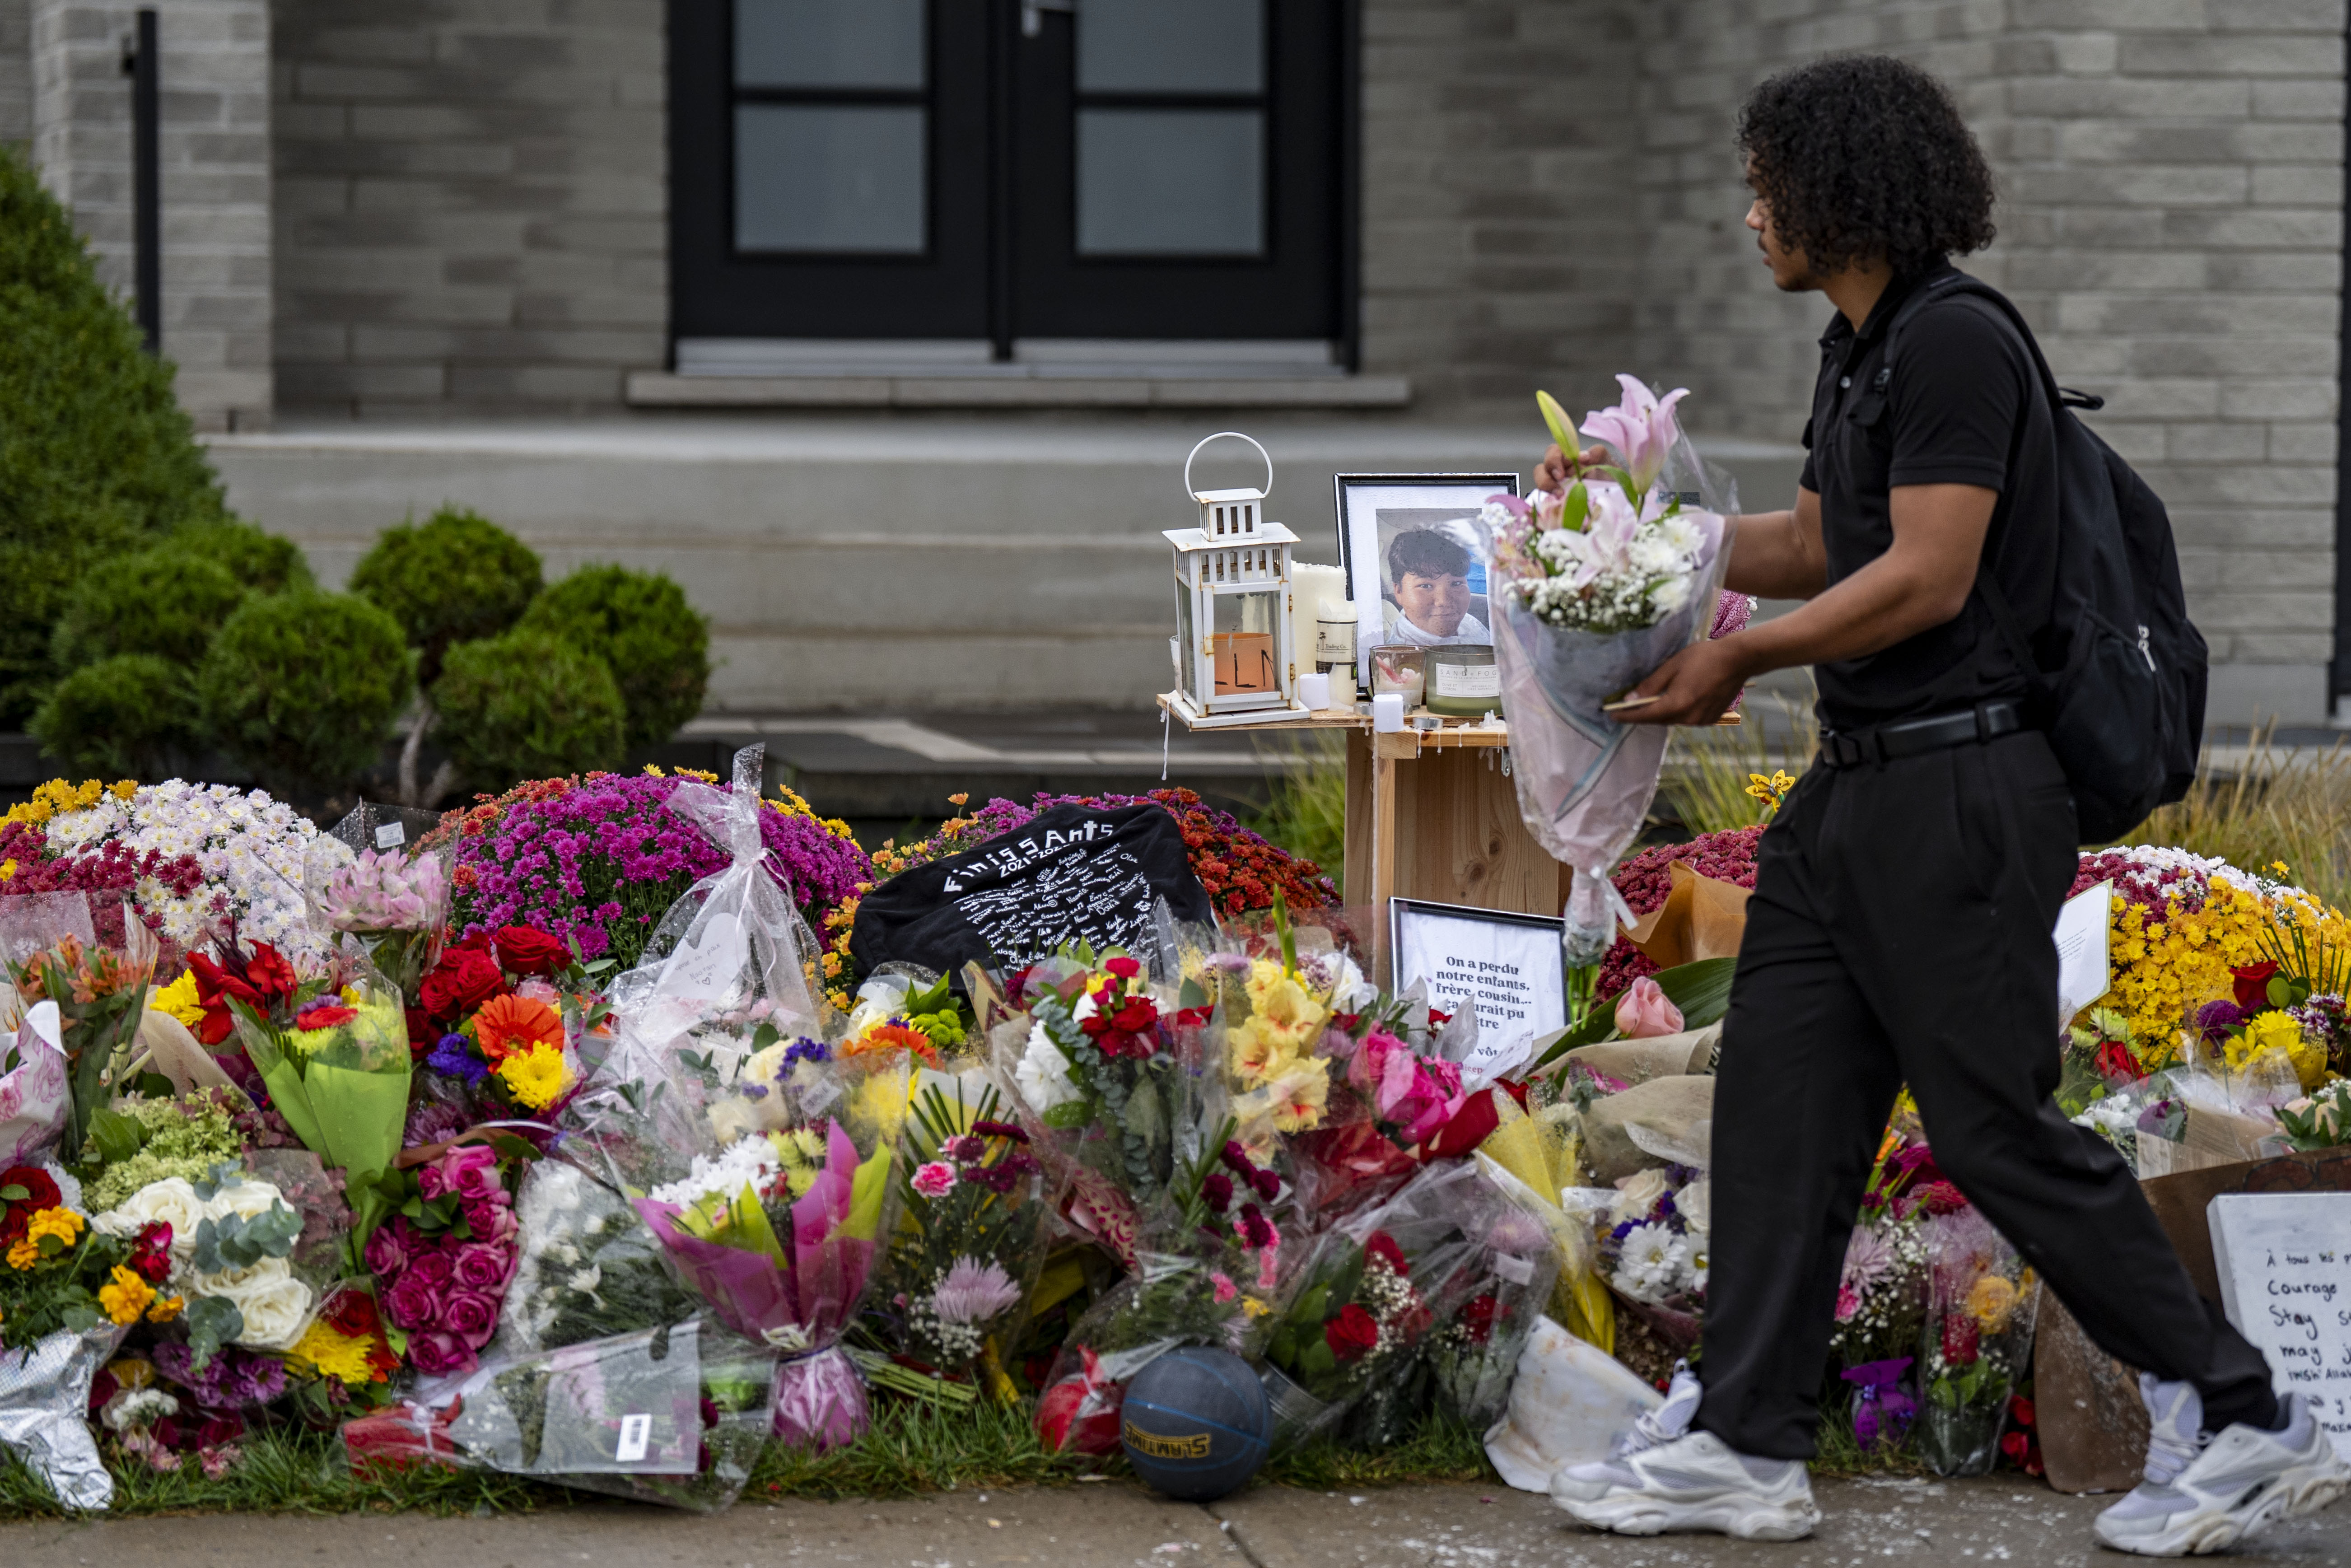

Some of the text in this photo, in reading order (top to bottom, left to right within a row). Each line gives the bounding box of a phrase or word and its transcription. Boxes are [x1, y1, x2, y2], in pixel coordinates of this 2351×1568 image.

[999, 844, 1070, 878] 2021-202
[1446, 956, 1519, 975] On a perdu
[1437, 971, 1530, 992] notre enfants,
[1474, 1003, 1505, 1016] urait
[1507, 1009, 1525, 1020] pu
[2267, 1279, 2337, 1302] Courage
[2268, 1304, 2318, 1341] Stay
[2279, 1344, 2322, 1366] may
